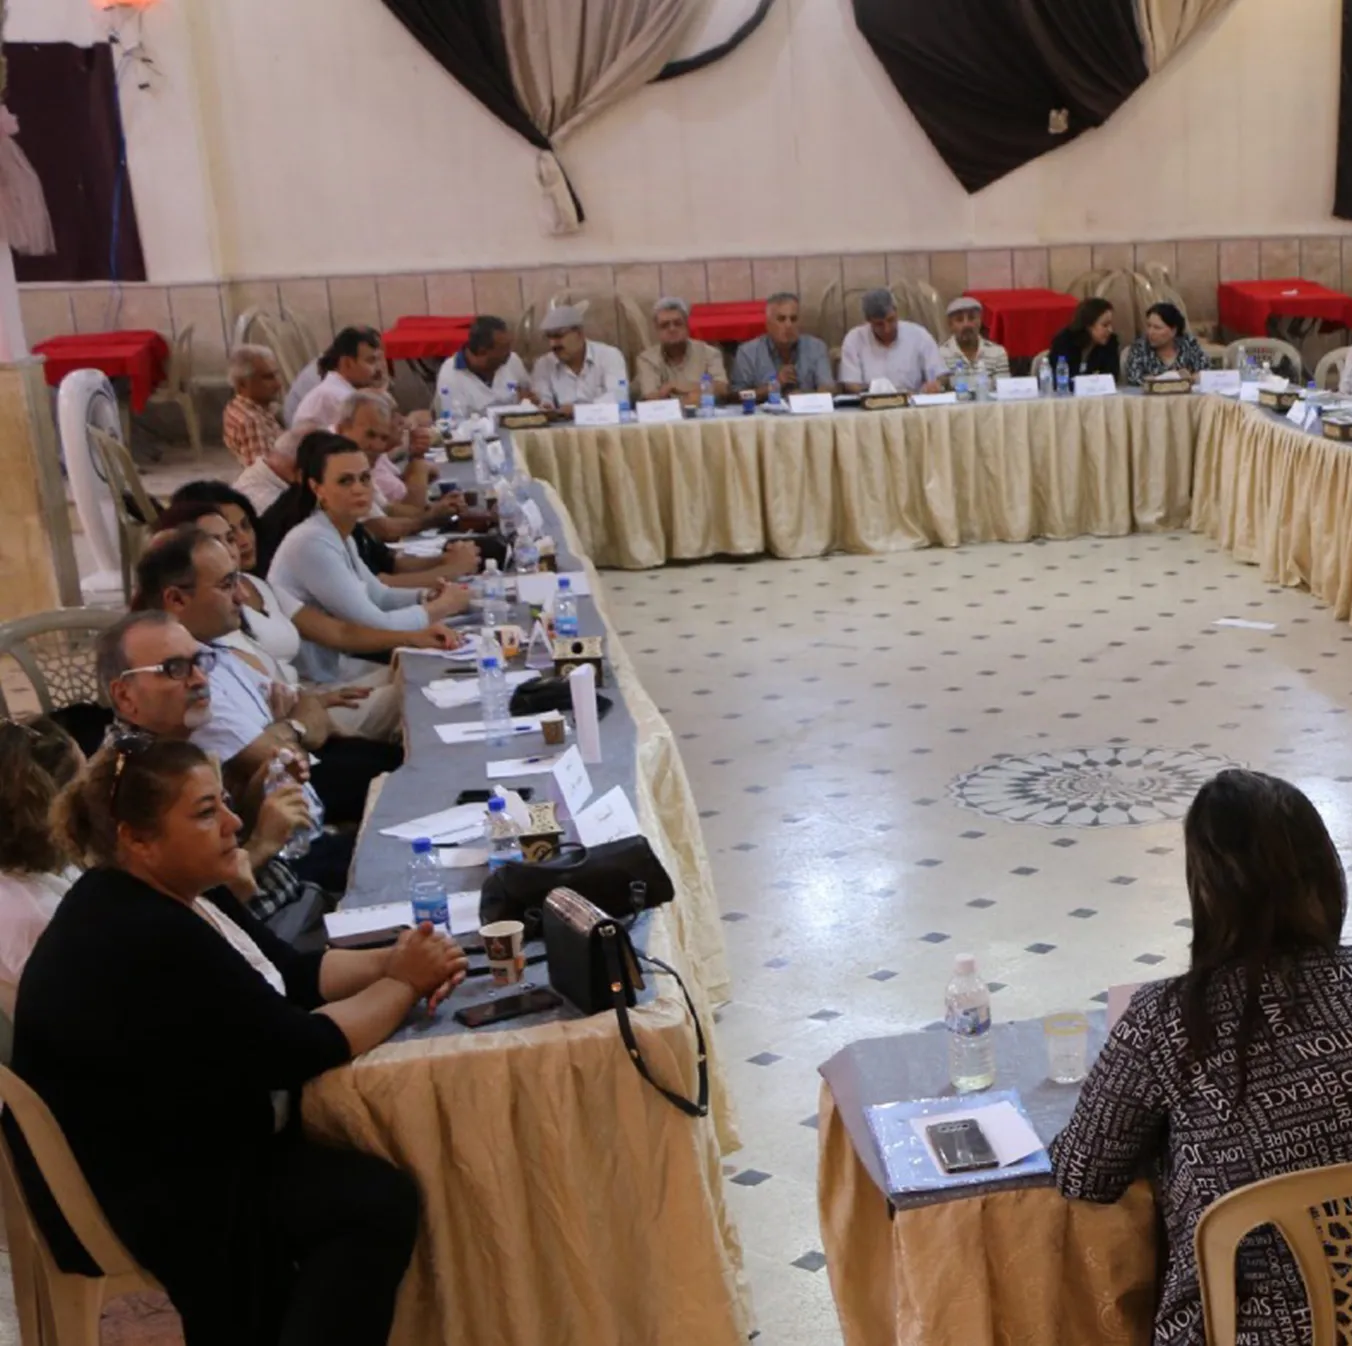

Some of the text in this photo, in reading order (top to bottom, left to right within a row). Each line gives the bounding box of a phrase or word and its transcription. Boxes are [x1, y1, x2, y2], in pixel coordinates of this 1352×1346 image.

[1166, 1018, 1232, 1121] HAPINESS
[1256, 1078, 1325, 1109] PEACE
[1264, 1118, 1338, 1149] PLEASURE
[1212, 1145, 1246, 1165] LOVE
[1259, 1140, 1316, 1168] LOVELY
